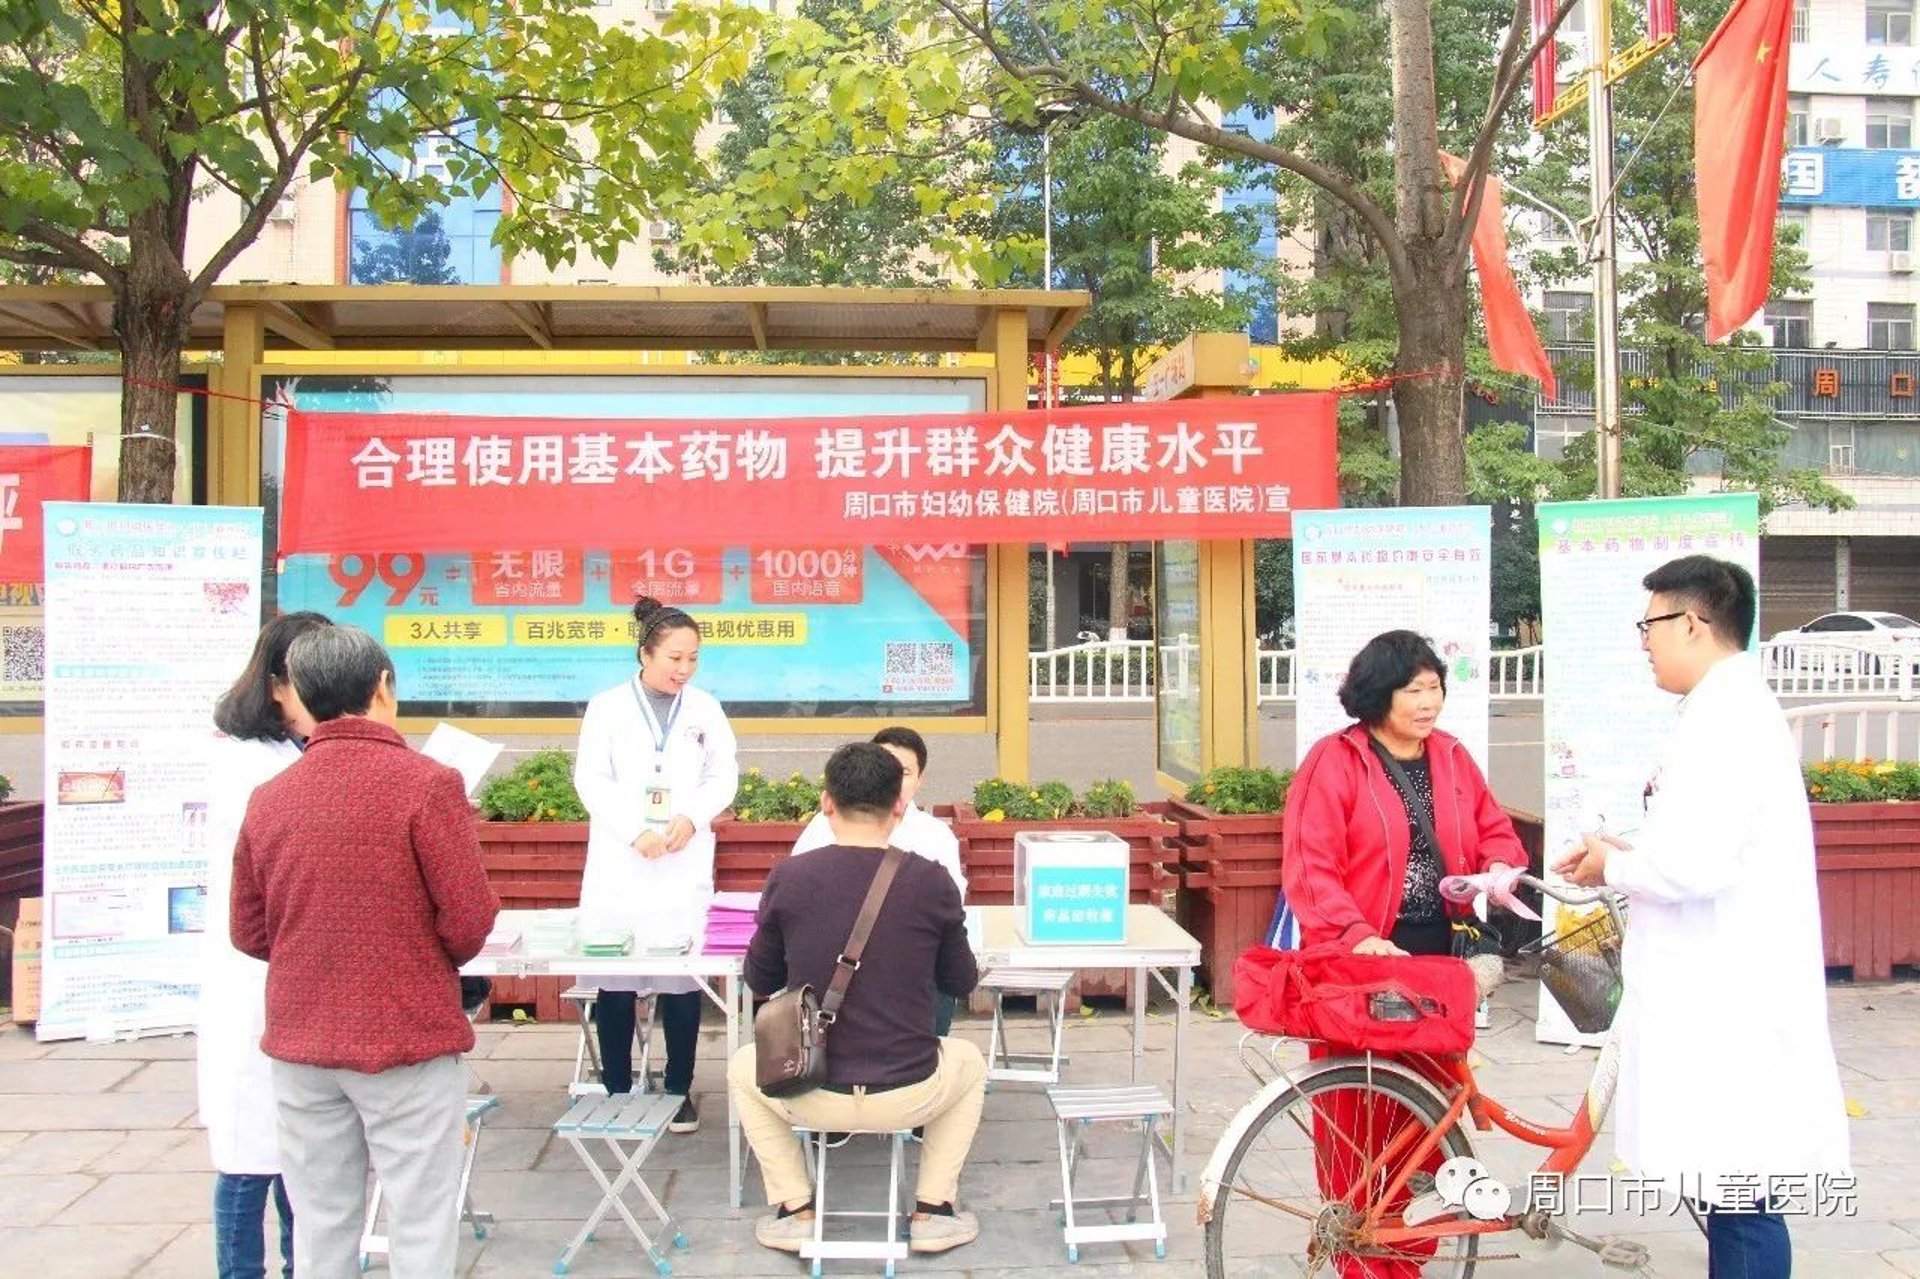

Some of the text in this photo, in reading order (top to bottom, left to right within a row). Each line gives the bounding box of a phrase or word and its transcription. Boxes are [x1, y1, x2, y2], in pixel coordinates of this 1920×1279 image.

[1813, 367, 1914, 398] 周口
[350, 421, 1265, 489] 合理使用基本药物 提升群众健康水平
[491, 549, 565, 579] 无限
[636, 549, 695, 578] 1G
[772, 580, 841, 597] 国内语音
[410, 621, 482, 640] 3人共享
